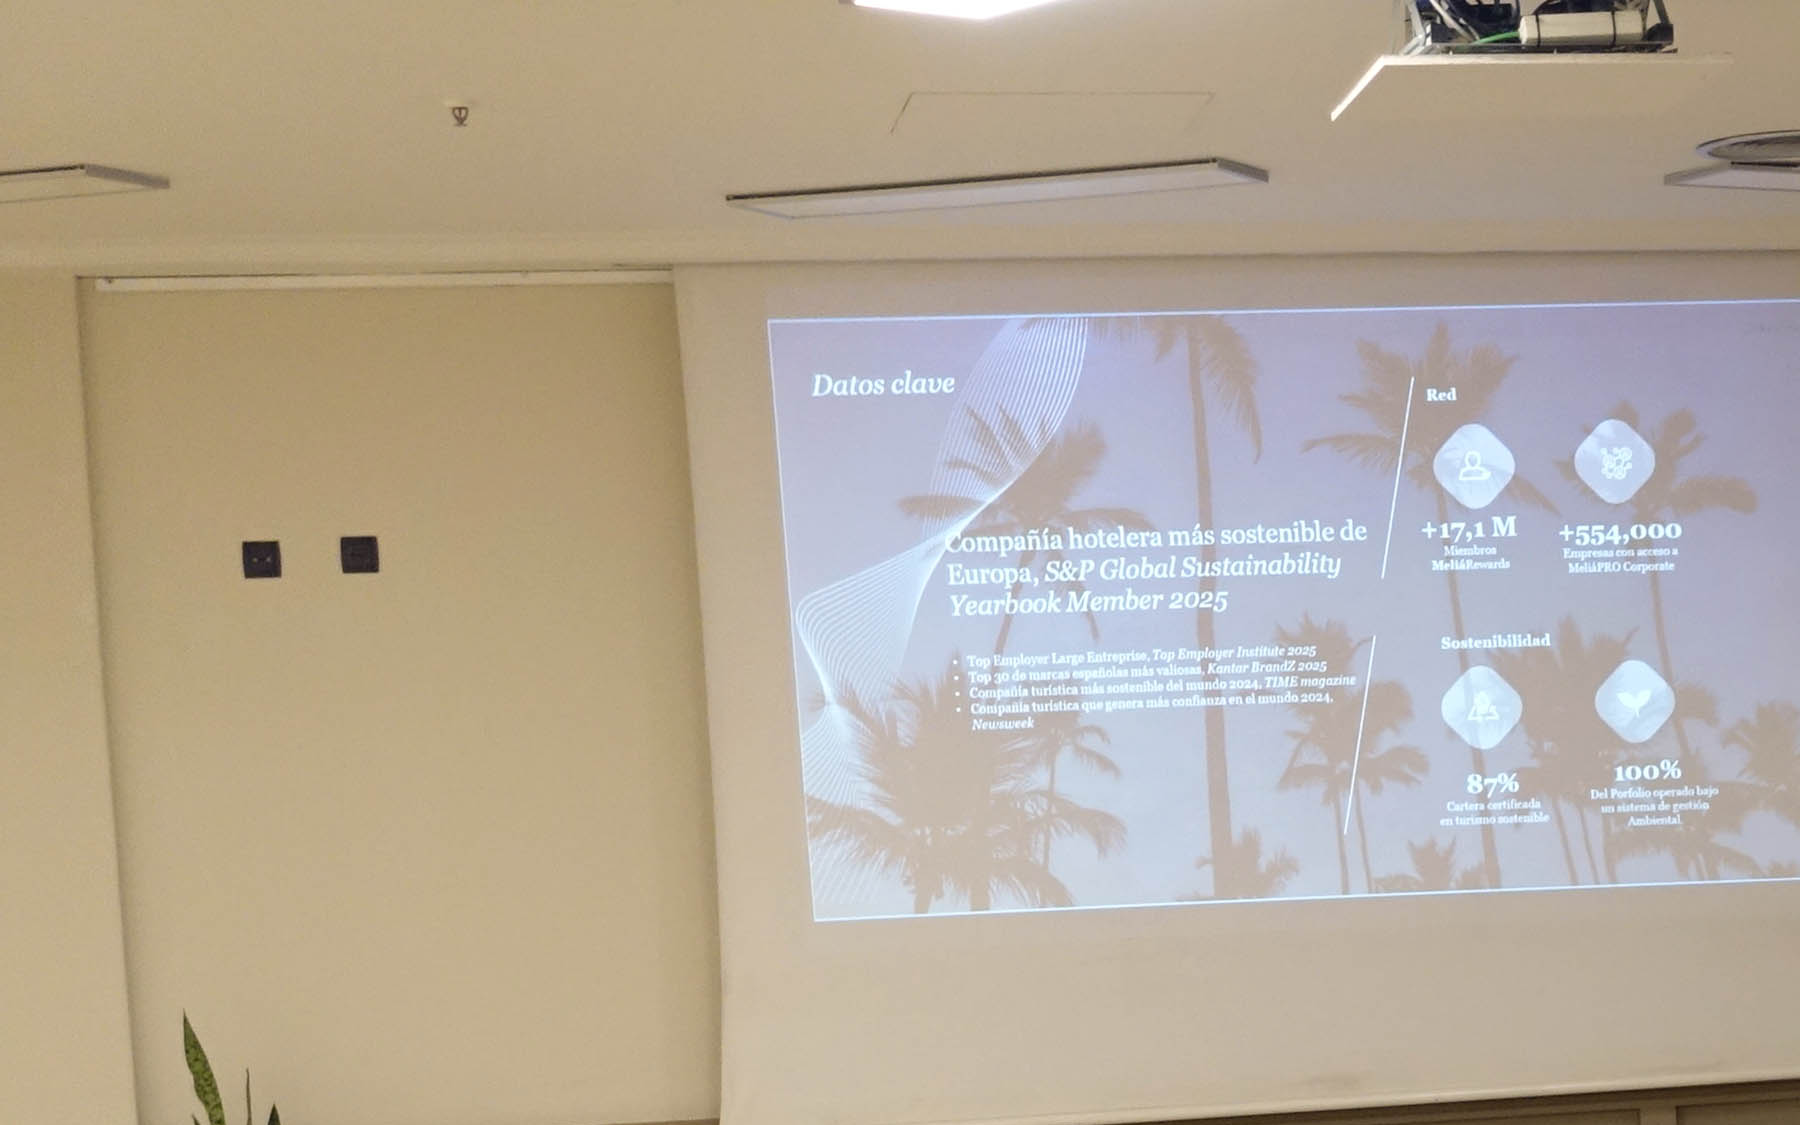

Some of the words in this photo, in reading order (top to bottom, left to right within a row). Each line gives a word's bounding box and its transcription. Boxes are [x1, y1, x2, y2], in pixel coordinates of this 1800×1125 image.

[812, 373, 885, 397] Datos
[891, 369, 955, 395] clave
[1426, 387, 1457, 402] Red
[945, 527, 1063, 558] Compañía
[1067, 526, 1163, 550] hotelera
[1167, 523, 1215, 546] más
[1220, 520, 1335, 545] sostenible
[1340, 518, 1368, 542] de
[1421, 521, 1486, 543] +17,1
[1491, 515, 1518, 538] M
[1559, 522, 1682, 546] +554,000
[1444, 545, 1497, 557] Miembros
[1563, 547, 1614, 561] Empresas
[1615, 548, 1635, 557] con
[1637, 546, 1671, 556] acceso
[947, 562, 1039, 589] Europa,
[1043, 559, 1095, 582] S&P
[1099, 554, 1176, 581] Global
[1180, 551, 1342, 579] Sustainability
[1623, 560, 1675, 574] Corporate
[949, 590, 1061, 617] Yearbook
[1066, 588, 1164, 613] Member
[1168, 590, 1229, 613] 2025
[1441, 632, 1551, 650] Sostenibilidad
[966, 654, 990, 668] Top
[993, 652, 1049, 667] Employer
[1052, 652, 1084, 665] Large
[1087, 649, 1151, 665] Entreprise,
[1153, 649, 1175, 662] Top
[1178, 647, 1233, 662] Employer
[1236, 646, 1285, 659] Institute
[1288, 646, 1317, 658] 2025
[968, 671, 991, 684] Top
[994, 672, 1009, 684] 30
[1011, 669, 1026, 681] de
[1029, 669, 1070, 681] marcas
[1072, 667, 1128, 682] españolas
[1131, 665, 1154, 677] más
[1157, 663, 1205, 677] valiosas,
[1207, 661, 1248, 675] Kantar
[1251, 659, 1297, 674] BrandZ
[1297, 661, 1328, 674] 2025
[969, 685, 1028, 701] Compañía
[1031, 683, 1078, 698] turística
[1081, 681, 1104, 695] más
[1107, 680, 1163, 695] sostenible
[1166, 678, 1183, 692] del
[1186, 677, 1227, 692] mundo
[1229, 678, 1262, 691] 2024,
[1264, 675, 1298, 689] TIME
[1300, 673, 1357, 689] magazine
[970, 701, 1029, 717] Compañía
[1032, 699, 1079, 713] turística
[1082, 700, 1102, 714] que
[1105, 698, 1144, 712] genera
[1146, 696, 1169, 709] más
[1172, 693, 1225, 707] confianza
[1228, 695, 1242, 706] en
[1245, 692, 1256, 704] el
[1258, 691, 1299, 705] mundo
[972, 716, 1035, 731] Newsweek
[1615, 758, 1682, 782] 100%
[1466, 772, 1520, 799] 87%
[1591, 787, 1608, 800] Del
[1653, 785, 1694, 799] operado
[1697, 784, 1719, 798] bajo
[1447, 800, 1485, 812] Cartera
[1487, 797, 1541, 811] certificada
[1601, 804, 1615, 814] un
[1617, 801, 1655, 814] sistema
[1658, 800, 1671, 811] de
[1672, 800, 1710, 813] gestión
[1440, 816, 1453, 827] en
[1456, 814, 1496, 826] turismo
[1497, 811, 1550, 825] sostenible
